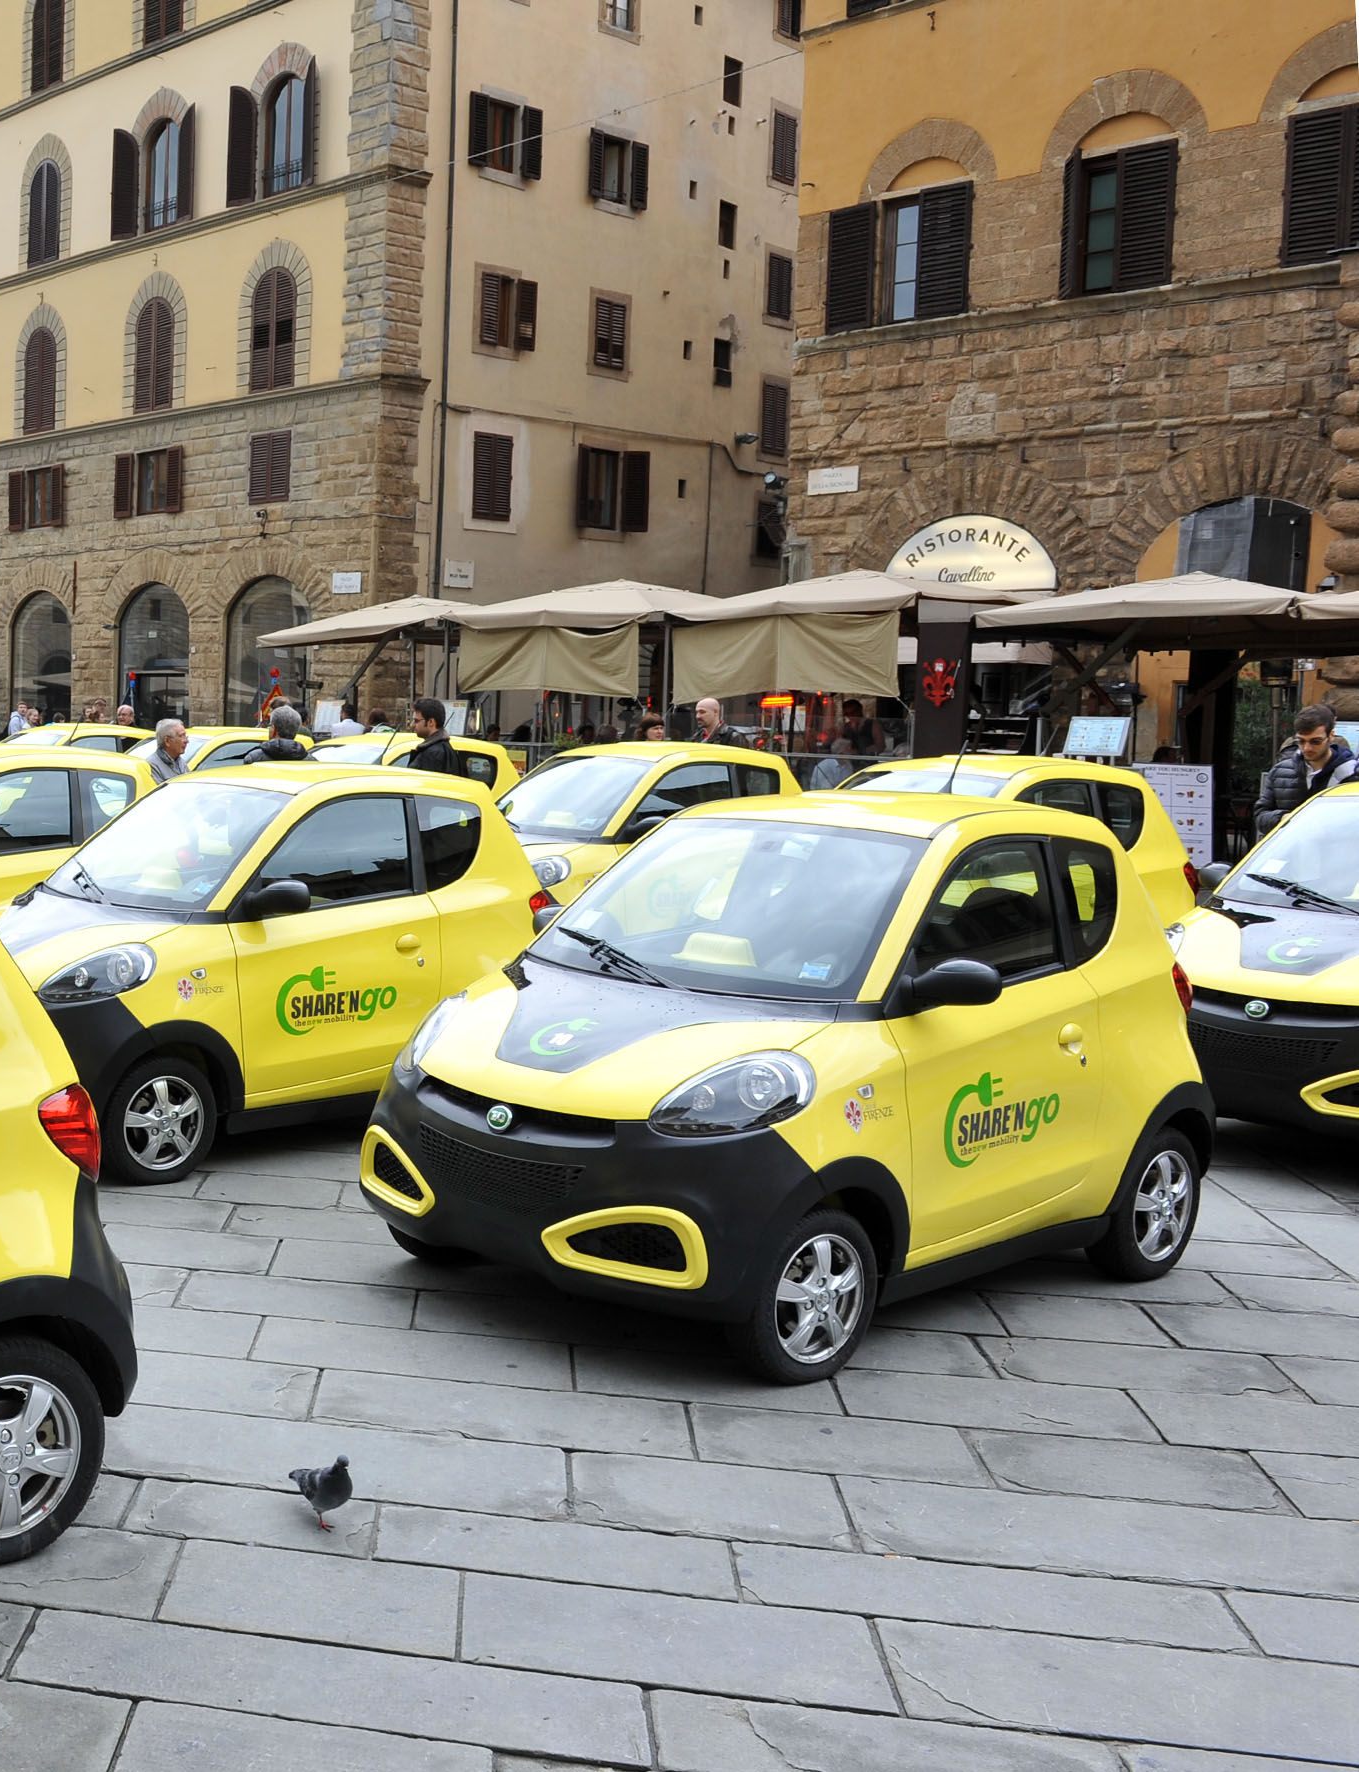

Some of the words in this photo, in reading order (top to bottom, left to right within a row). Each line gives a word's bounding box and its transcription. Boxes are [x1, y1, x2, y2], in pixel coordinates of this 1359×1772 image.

[905, 528, 1031, 568] RISTORANTE
[938, 566, 996, 583] Cavallino
[294, 1019, 306, 1027] the
[324, 1014, 355, 1024] mobility
[988, 1134, 1019, 1149] mobility
